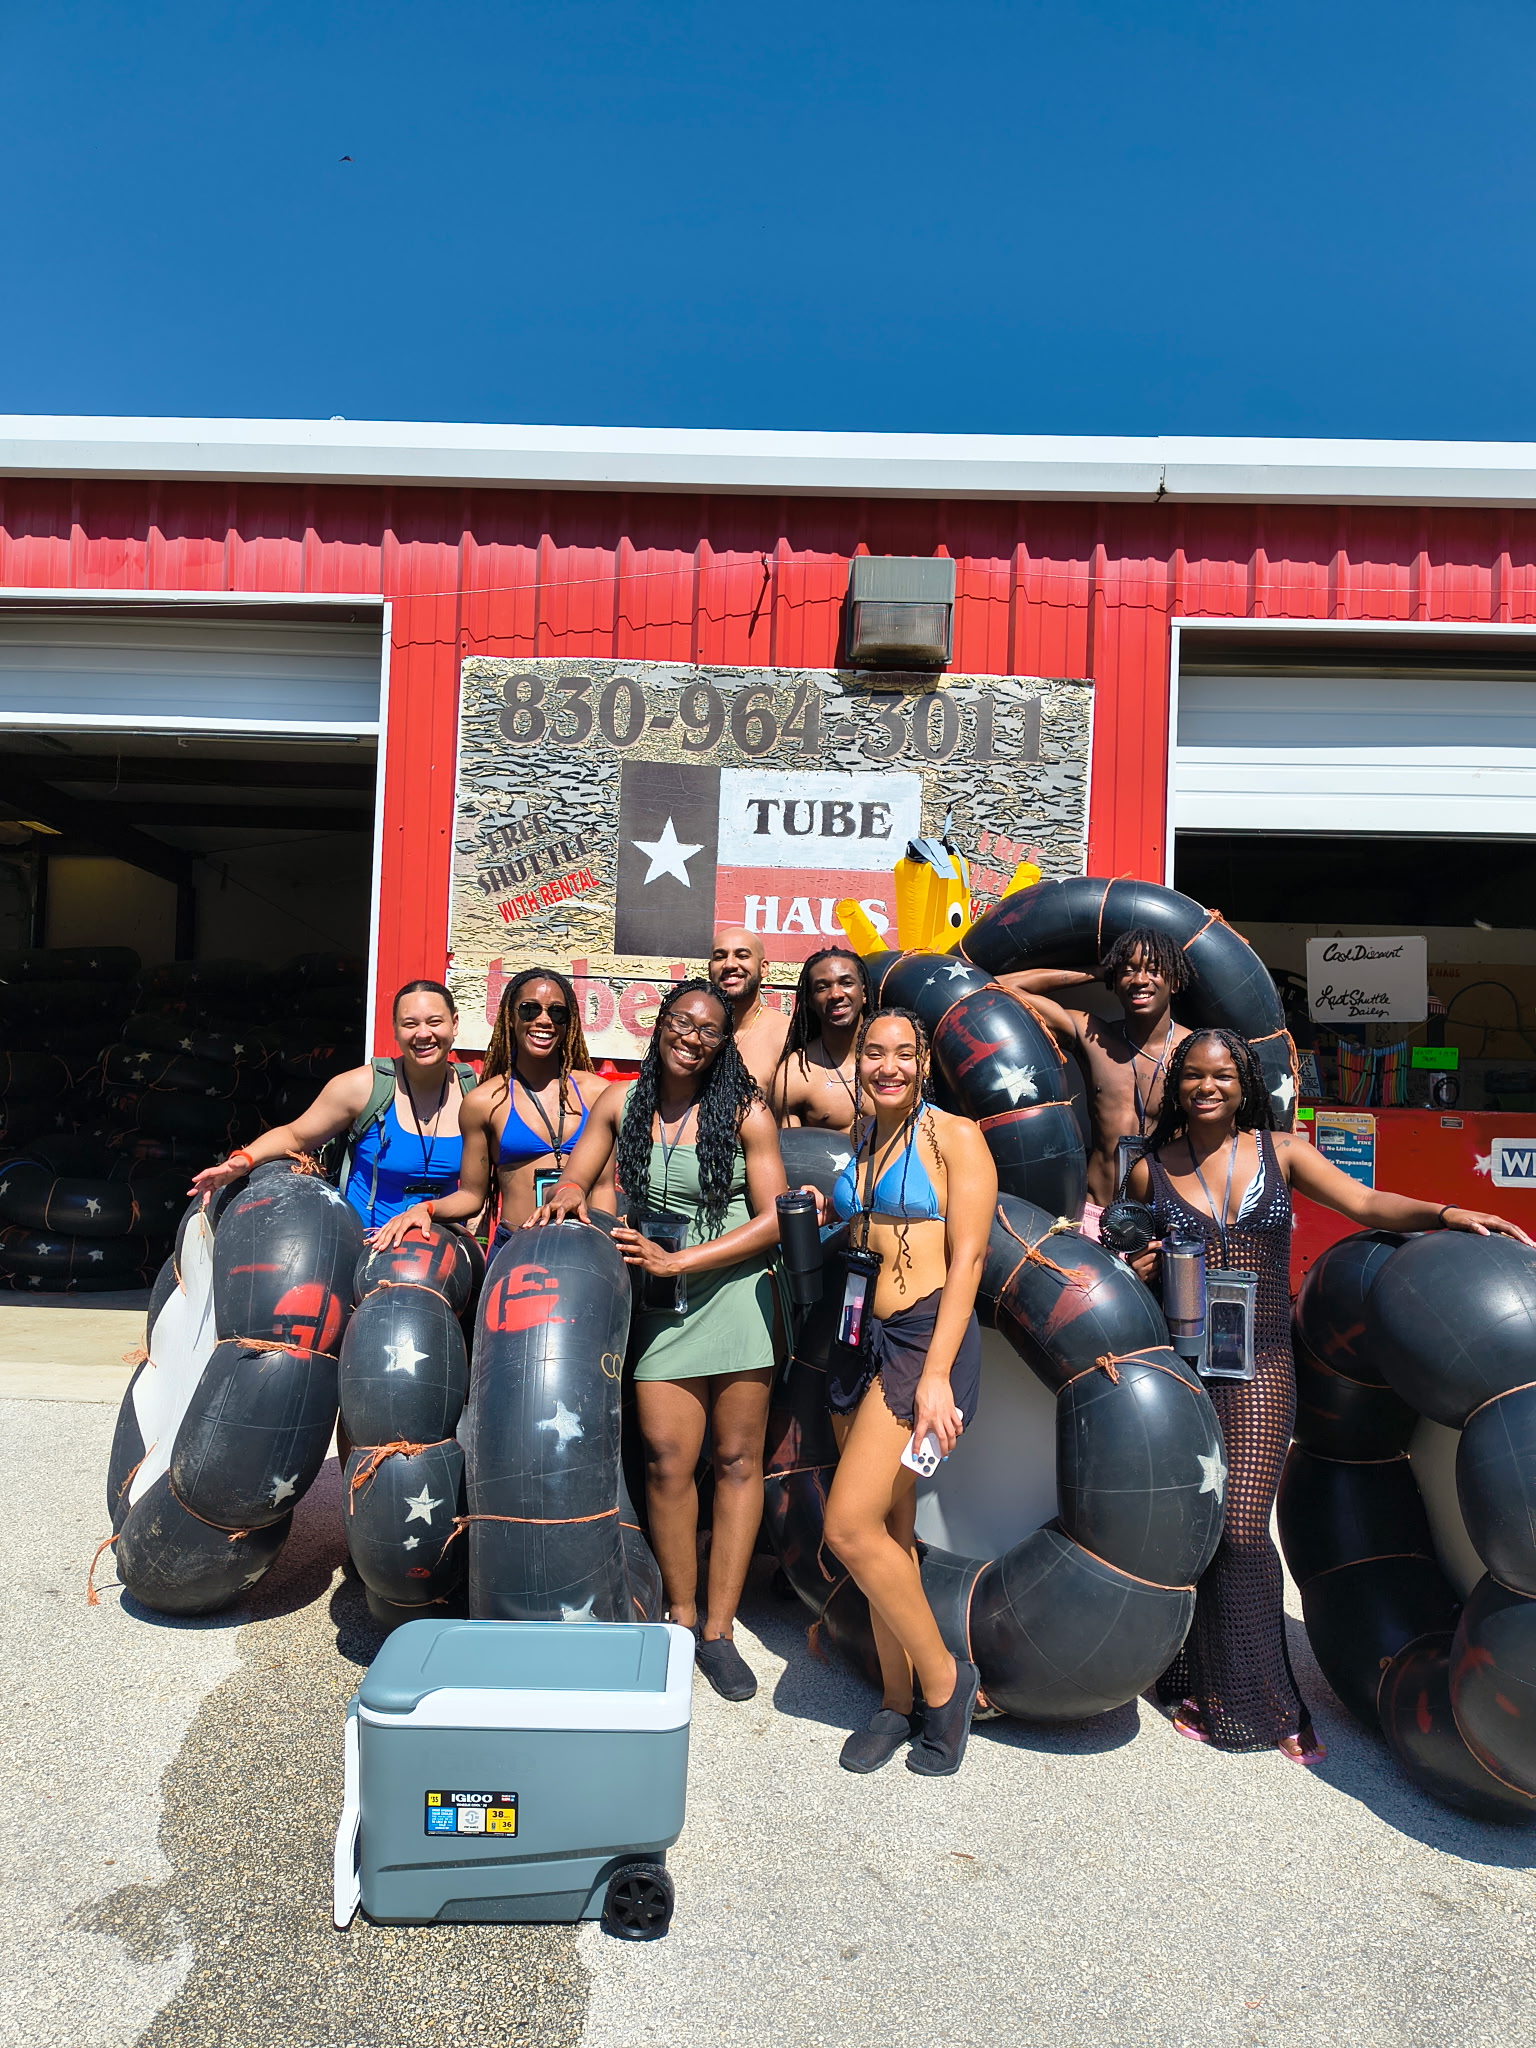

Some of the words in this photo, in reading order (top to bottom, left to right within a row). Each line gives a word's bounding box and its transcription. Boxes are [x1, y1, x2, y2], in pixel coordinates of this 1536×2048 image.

[500, 674, 1043, 763] 830-964-3011
[746, 799, 894, 839] TUBE
[486, 813, 552, 855] FREE
[497, 891, 541, 923] WITH
[540, 867, 600, 906] RENTAL
[744, 895, 890, 935] HAUS
[1352, 945, 1404, 962] Discount
[1315, 985, 1349, 1010] Last
[1350, 989, 1391, 1006] Shuttle
[1348, 1006, 1390, 1018] Daily
[1336, 1159, 1372, 1167] Trespassing
[451, 1793, 493, 1803] IGLOO
[492, 1810, 504, 1818] 38
